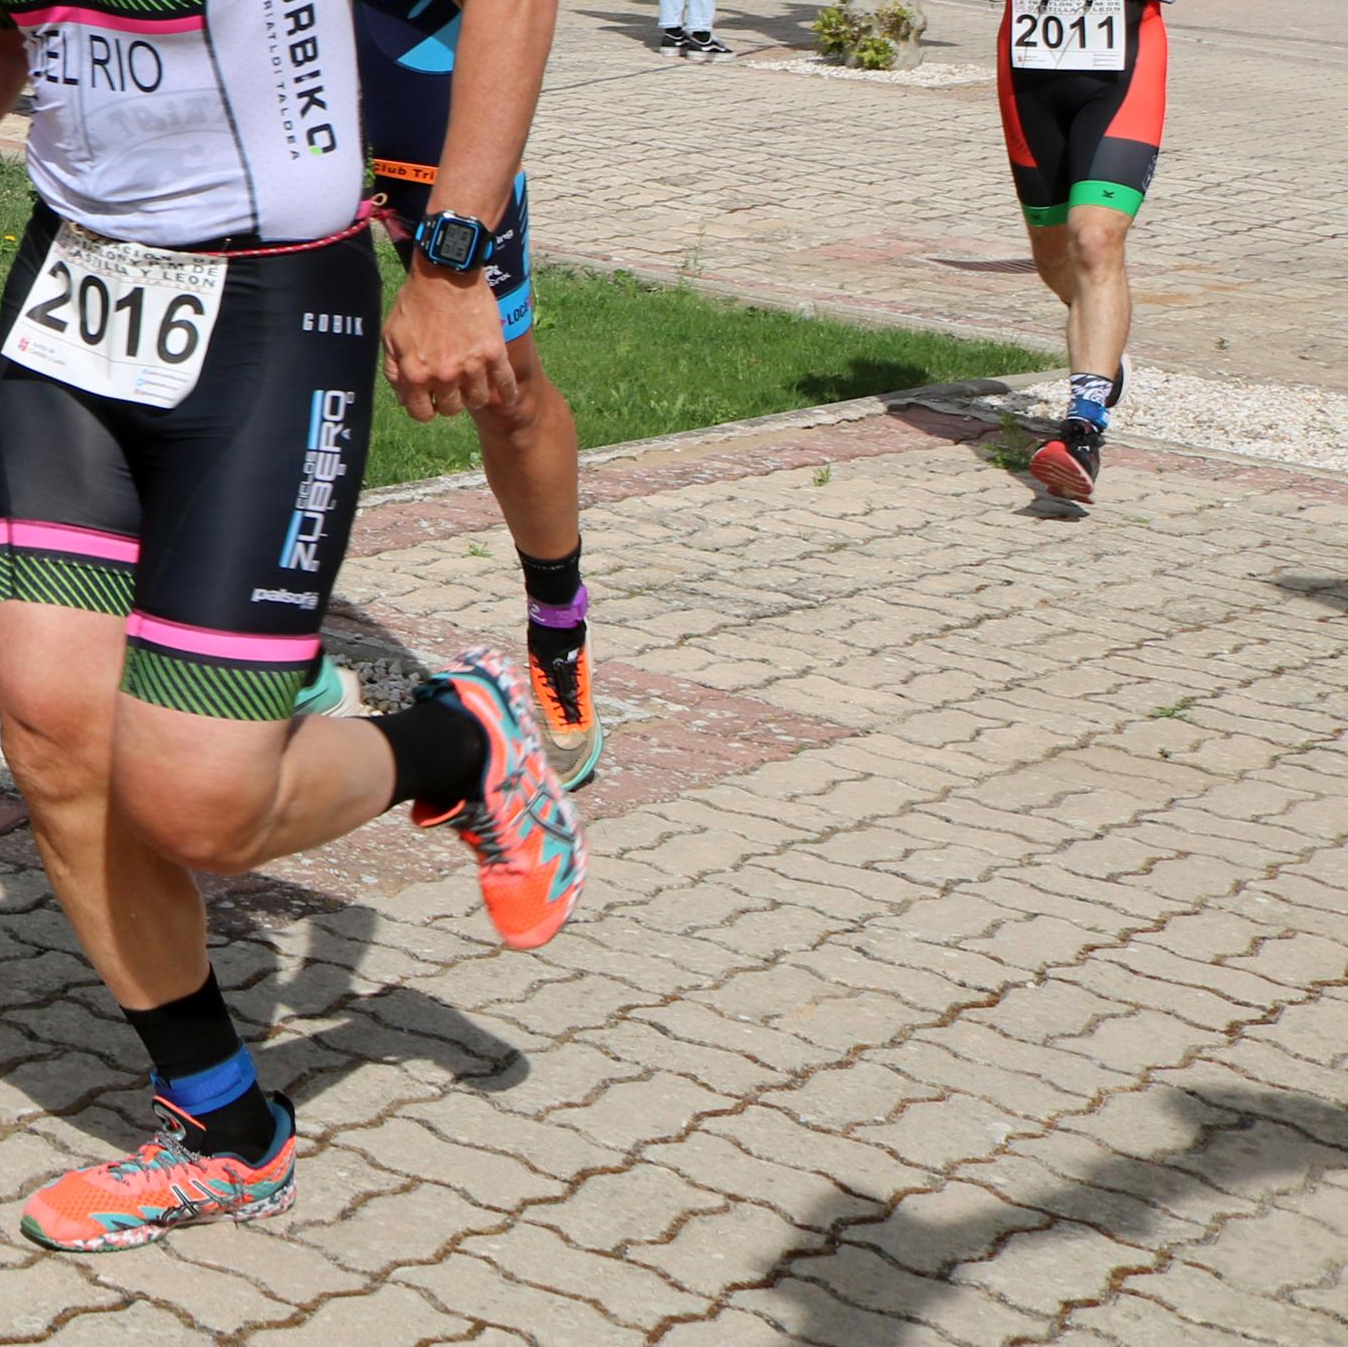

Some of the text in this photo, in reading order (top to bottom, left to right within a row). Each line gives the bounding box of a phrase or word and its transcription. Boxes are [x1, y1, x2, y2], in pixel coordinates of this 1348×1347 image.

[1015, 14, 1114, 49] 2011
[89, 34, 162, 93] RIO
[276, 82, 301, 160] TALDEA
[373, 163, 407, 175] Club
[140, 269, 151, 278] Y
[163, 271, 216, 288] LEON
[193, 264, 218, 277] DE
[25, 260, 205, 364] 2016
[303, 312, 364, 336] GOBIK
[289, 390, 346, 572] ZUBERO
